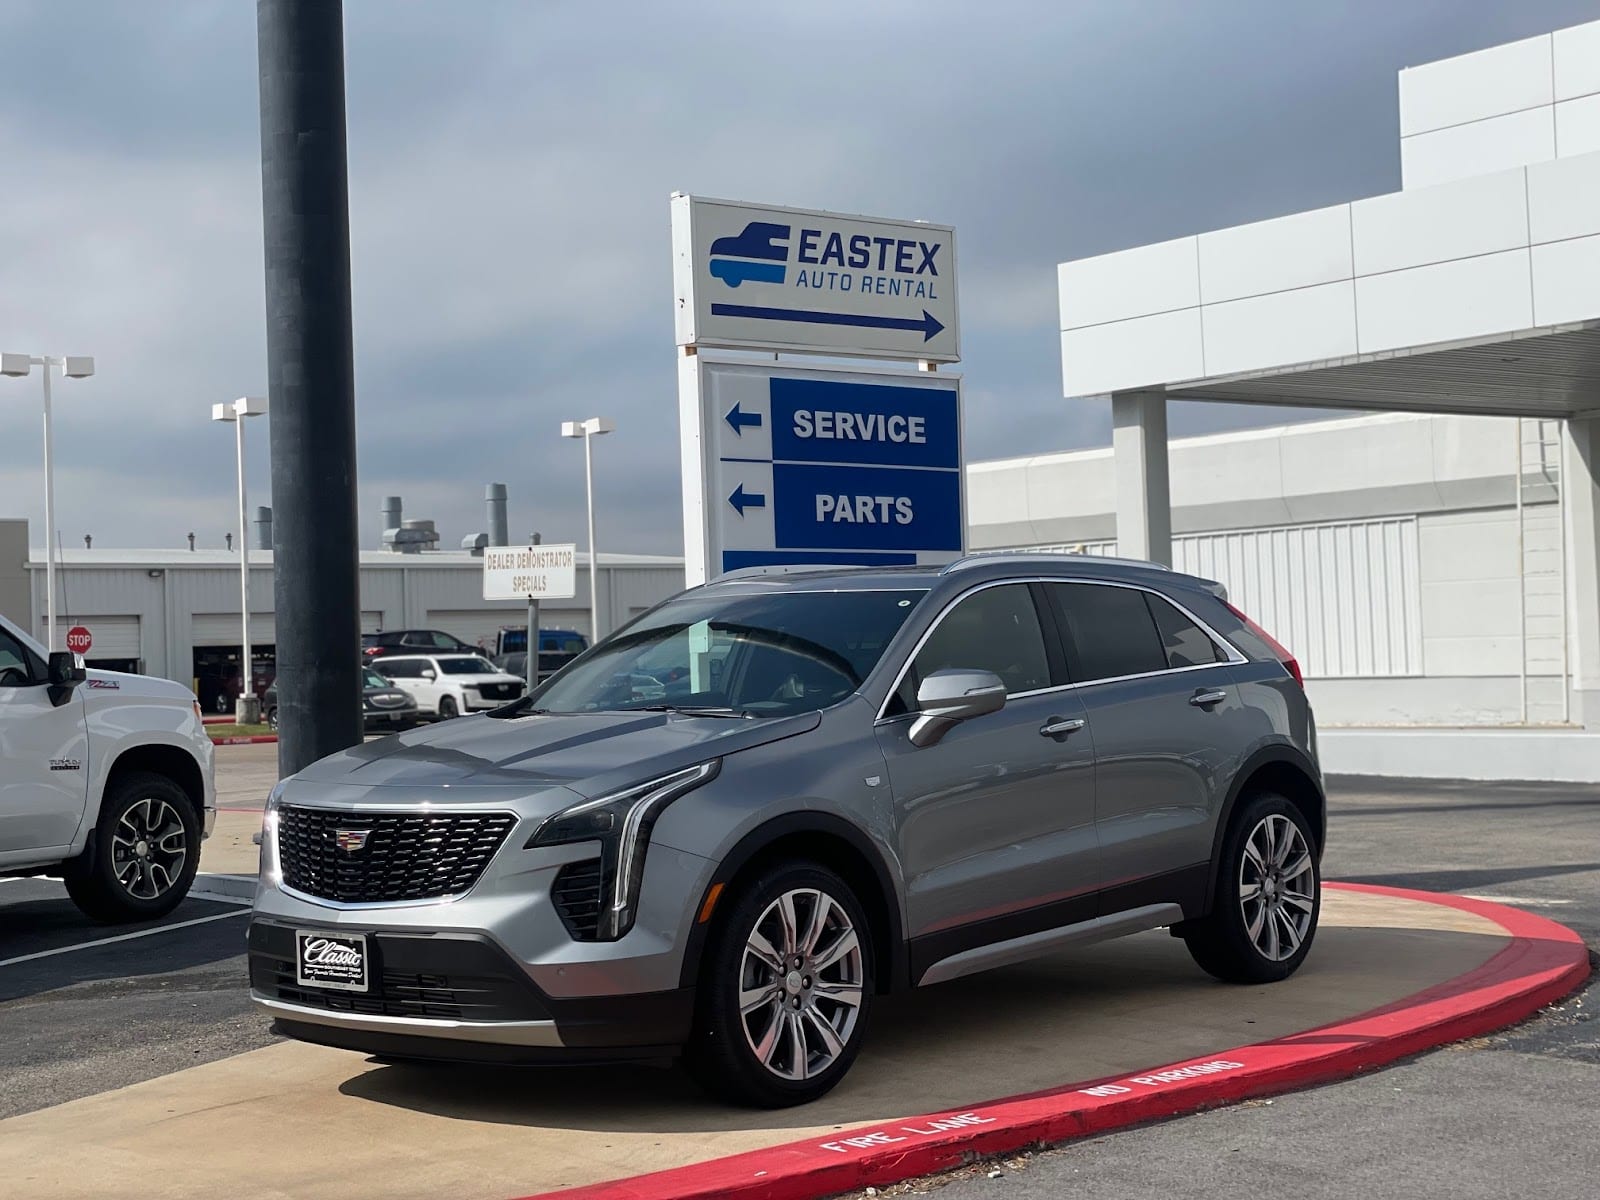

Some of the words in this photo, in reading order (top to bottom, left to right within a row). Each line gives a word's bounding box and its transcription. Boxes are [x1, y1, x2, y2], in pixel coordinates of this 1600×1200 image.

[798, 229, 941, 276] EASTEX
[796, 270, 852, 292] AUTO
[861, 276, 938, 299] RENTAL
[793, 410, 926, 444] SERVICE
[815, 494, 914, 525] PARTS
[487, 553, 514, 570] DEALER
[517, 551, 572, 568] DEMONSTRATOR
[513, 575, 546, 592] SPECIALS
[67, 634, 91, 647] STOP
[304, 935, 362, 965] Classic
[1078, 1084, 1132, 1097] NO
[1130, 1060, 1245, 1086] PARKING
[819, 1131, 907, 1153] FIRE
[900, 1112, 997, 1135] LANE
